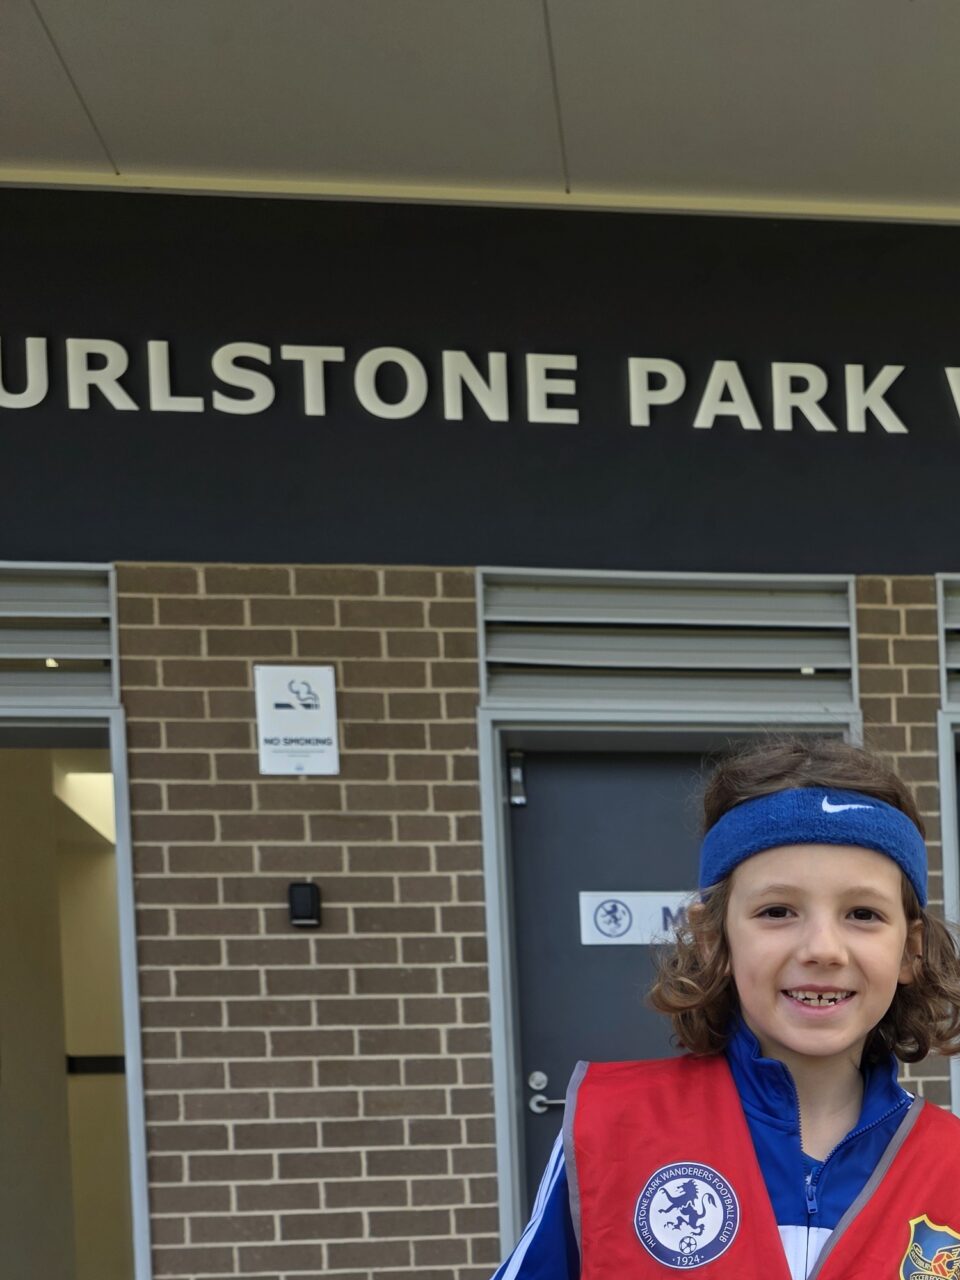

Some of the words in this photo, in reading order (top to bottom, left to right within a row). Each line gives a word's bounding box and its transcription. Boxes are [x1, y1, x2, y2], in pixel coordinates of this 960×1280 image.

[627, 356, 908, 435] PARK
[263, 737, 280, 746] NO
[283, 737, 333, 746] SMOKING
[659, 1167, 714, 1181] WANDERERS
[645, 1178, 662, 1197] PARK
[712, 1177, 735, 1219] FOOTBALL
[638, 1198, 657, 1248] HURLSTONE
[719, 1221, 734, 1243] CLUB
[676, 1254, 700, 1266] 1924
